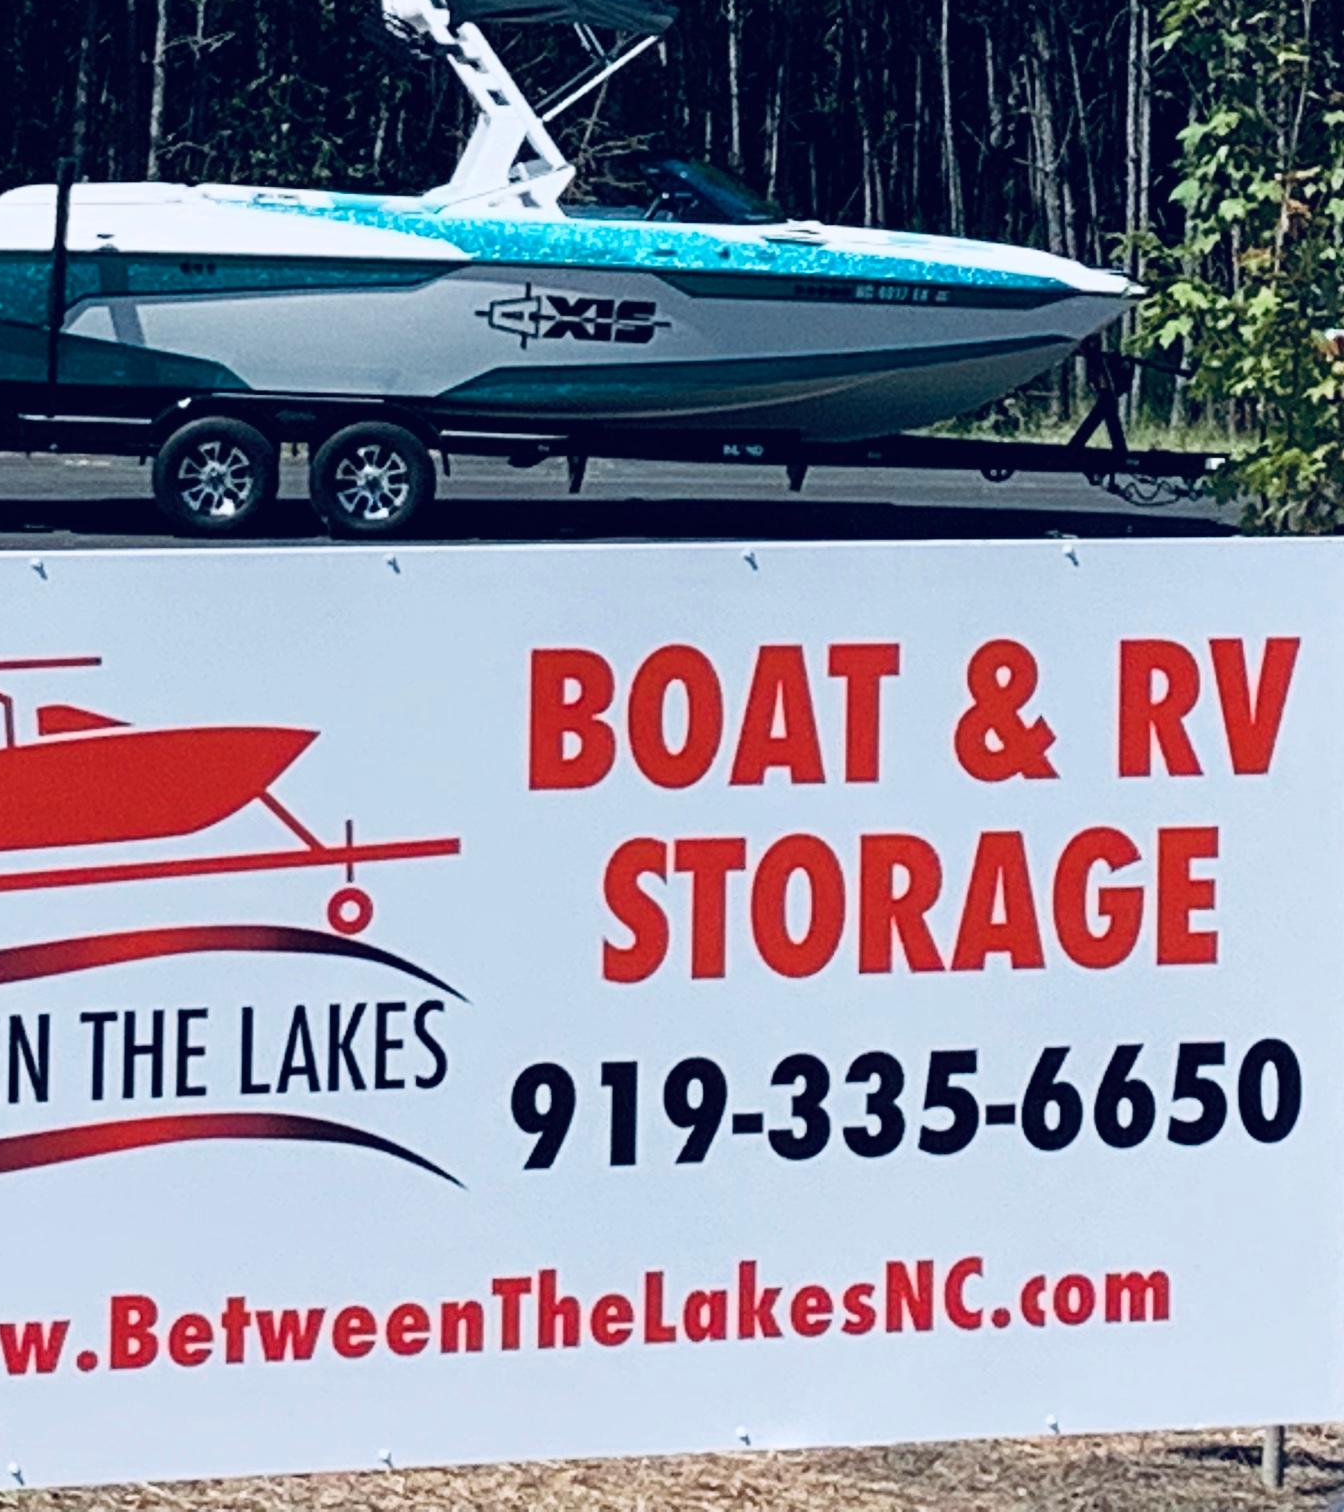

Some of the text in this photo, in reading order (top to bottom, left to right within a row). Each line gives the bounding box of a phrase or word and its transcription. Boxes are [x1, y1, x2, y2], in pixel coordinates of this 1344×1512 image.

[476, 288, 670, 346] AXIS
[528, 637, 1301, 791] BOAT & RV
[602, 826, 1219, 984] STORAGE
[79, 1007, 210, 1101] THE
[240, 999, 449, 1095] LAKES
[510, 1038, 1302, 1171] 919-335-6650
